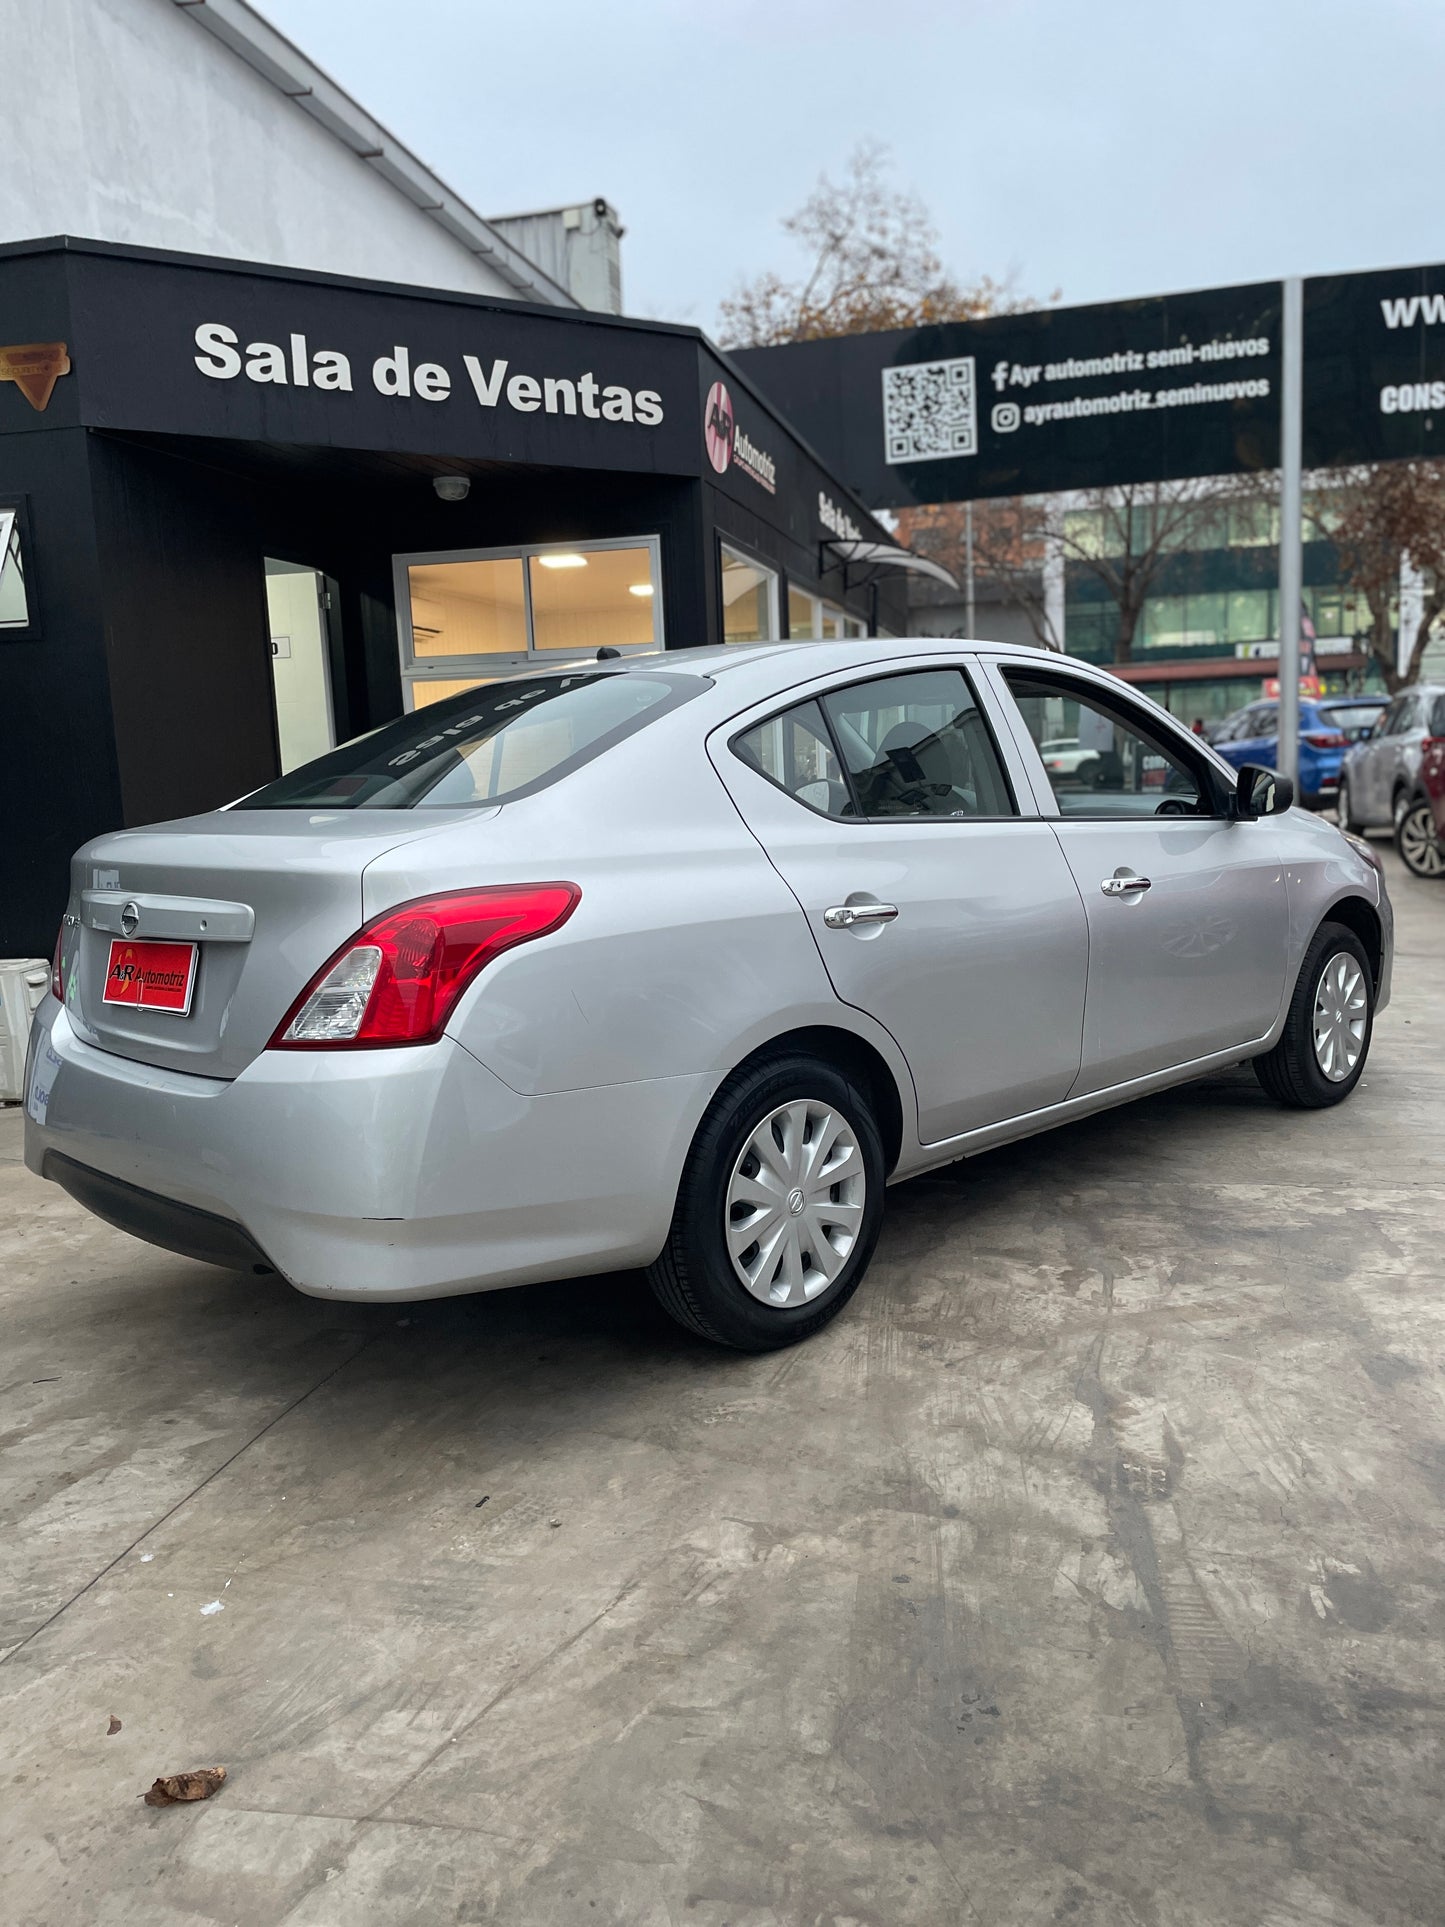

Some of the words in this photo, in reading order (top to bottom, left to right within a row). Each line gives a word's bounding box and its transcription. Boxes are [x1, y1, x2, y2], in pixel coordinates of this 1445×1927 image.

[194, 323, 353, 391] Sala
[372, 345, 451, 402] de
[462, 354, 664, 426] Ventas
[1009, 361, 1043, 388] Ayr
[1044, 350, 1144, 381] automotriz
[1146, 337, 1270, 368] semi-nuevos
[1380, 381, 1445, 414] CONS
[733, 424, 776, 485] Automotriz
[135, 968, 184, 987] Automotriz
